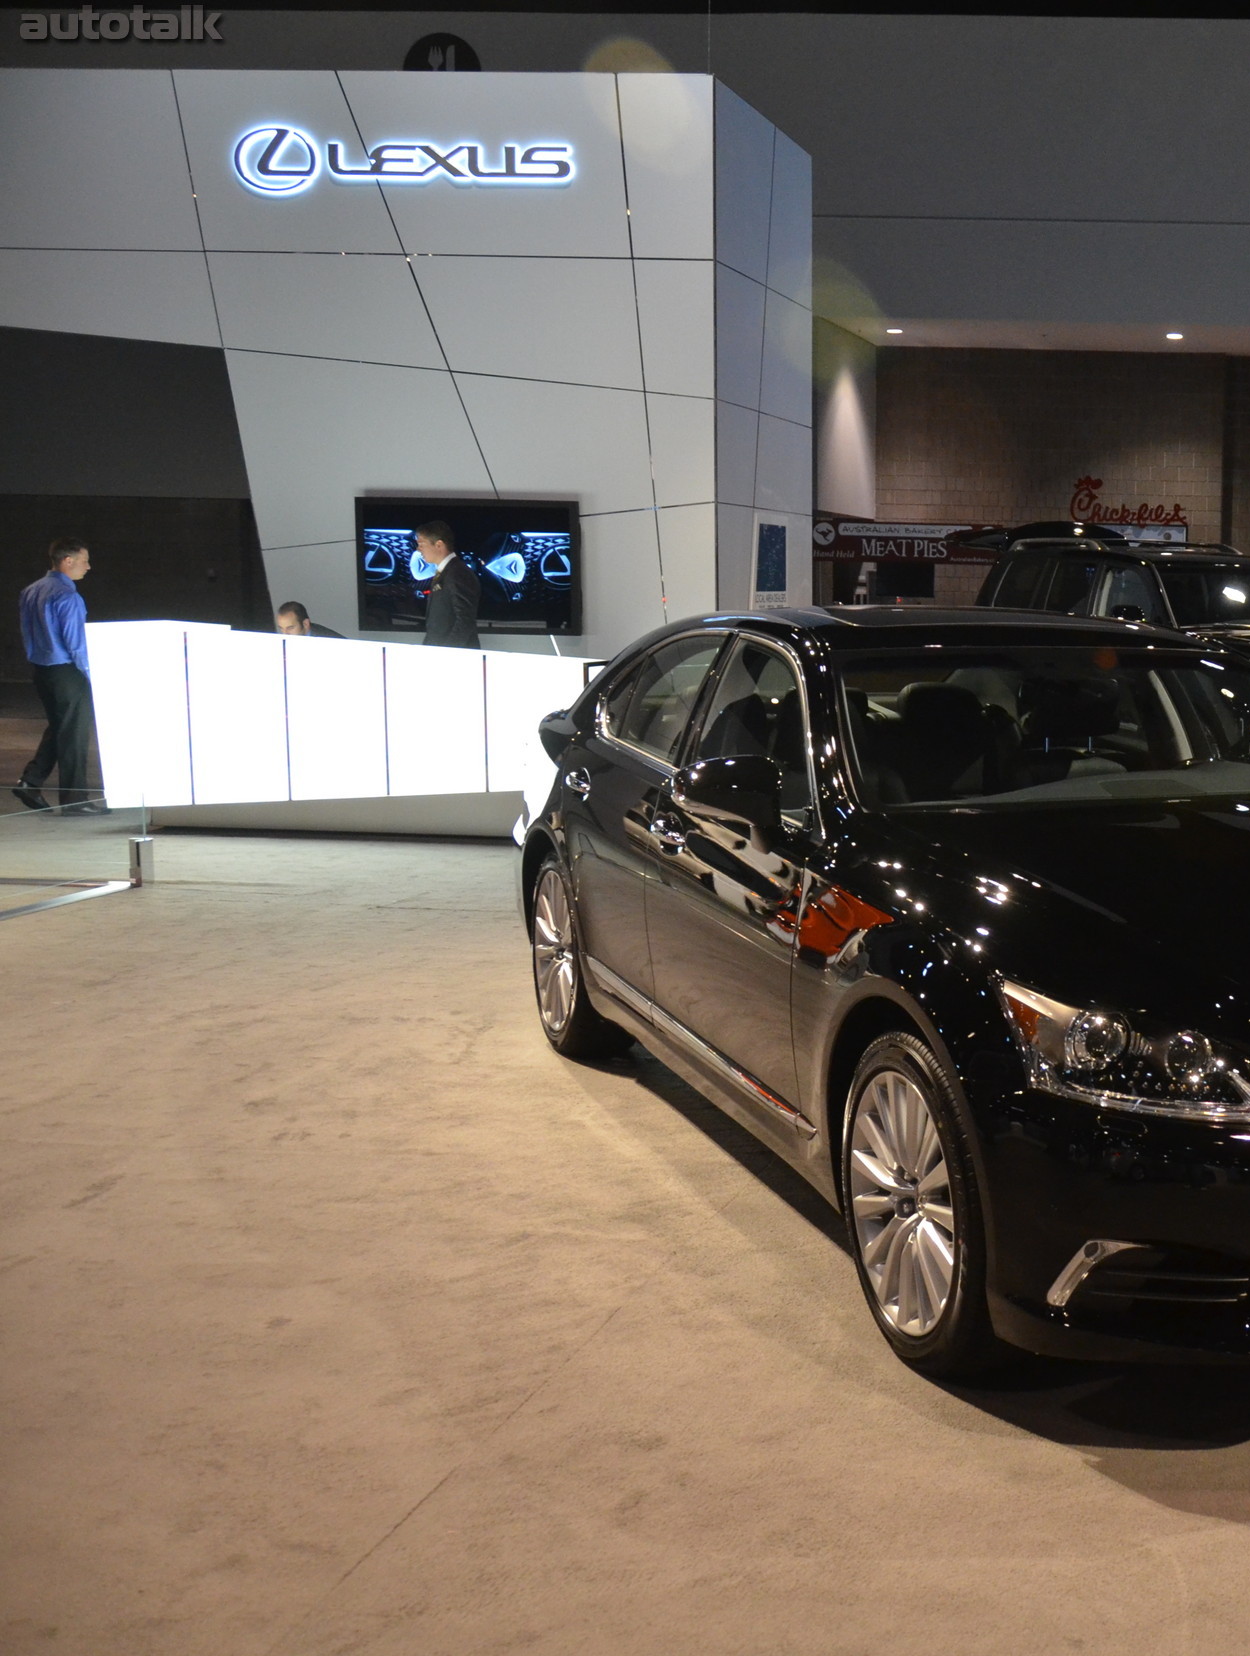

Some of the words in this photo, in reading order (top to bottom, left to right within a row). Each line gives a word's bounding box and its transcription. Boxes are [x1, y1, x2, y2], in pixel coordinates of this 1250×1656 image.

[327, 143, 572, 178] LEXUS
[1070, 475, 1189, 529] Chick-fil-A
[842, 525, 900, 534] AUSTRALIAN
[904, 526, 944, 535] BAKERY
[813, 549, 835, 558] Hand
[836, 550, 855, 559] Held
[860, 538, 911, 558] MEAT
[914, 539, 947, 559] PIES
